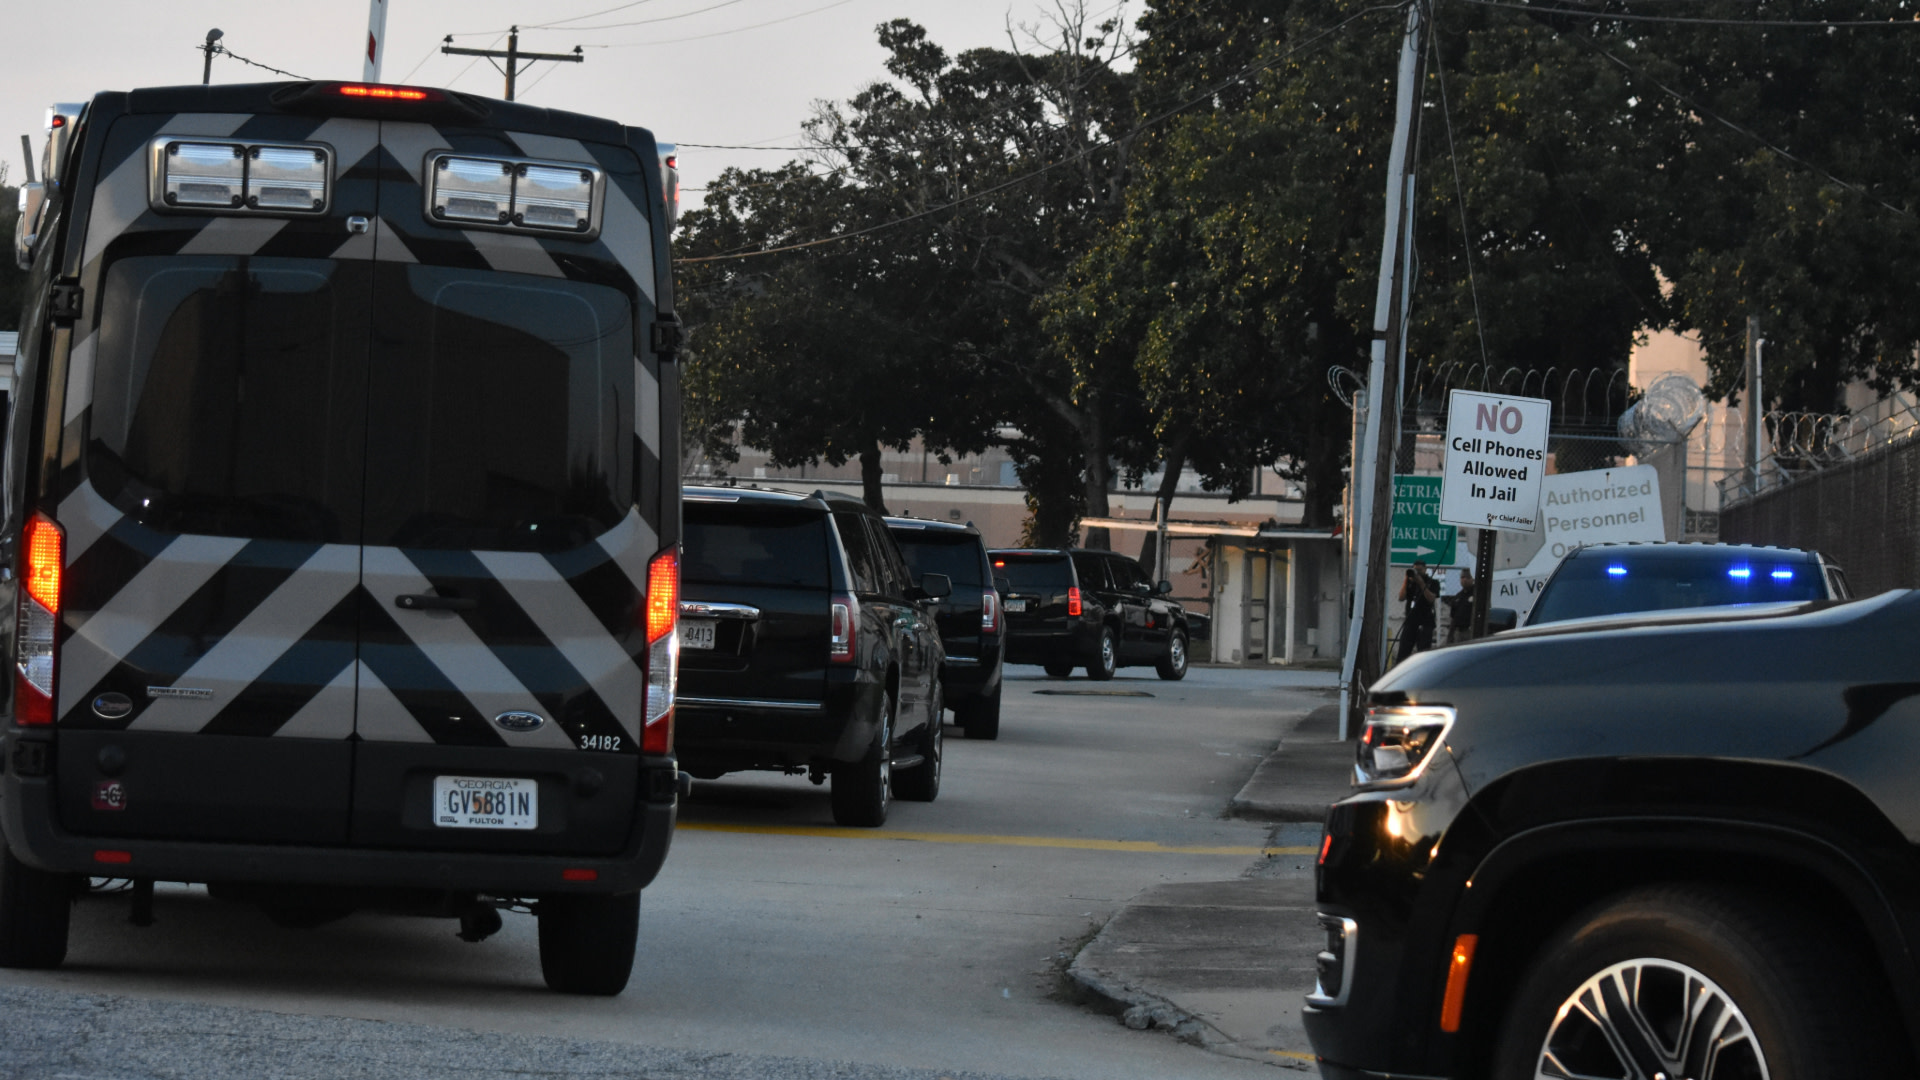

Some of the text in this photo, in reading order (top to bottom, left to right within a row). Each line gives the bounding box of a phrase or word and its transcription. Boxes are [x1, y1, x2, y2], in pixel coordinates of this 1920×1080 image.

[1476, 403, 1523, 434] NO
[1452, 437, 1542, 460] Cell Phones
[1463, 461, 1528, 480] Allowed
[1393, 484, 1440, 498] RETRIA
[1471, 483, 1516, 501] In Jail
[1546, 480, 1651, 506] Authorized
[1487, 513, 1533, 525] Per Chief Jailer
[1547, 506, 1645, 532] Personnel
[1392, 527, 1448, 540] TAKE UNIT
[581, 735, 620, 750] 34182
[458, 780, 512, 790] GEORGIA
[448, 789, 530, 816] GV5881N
